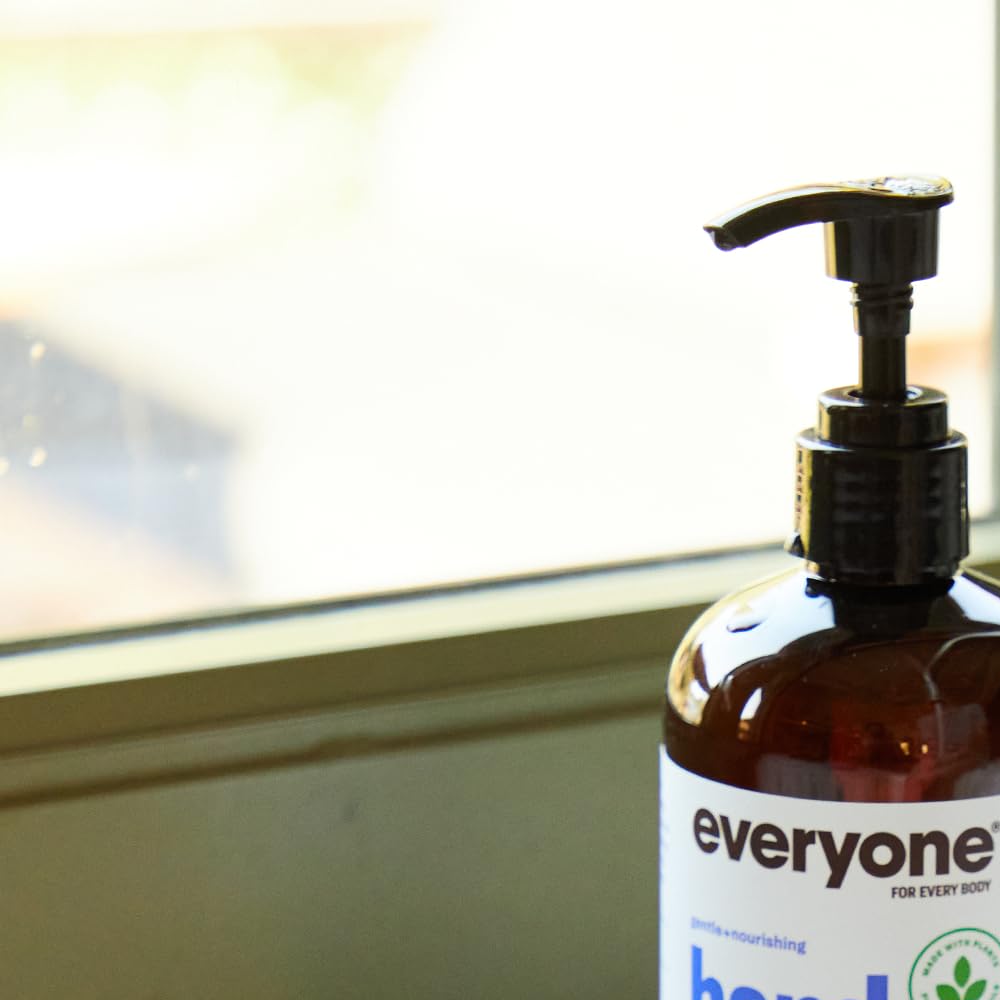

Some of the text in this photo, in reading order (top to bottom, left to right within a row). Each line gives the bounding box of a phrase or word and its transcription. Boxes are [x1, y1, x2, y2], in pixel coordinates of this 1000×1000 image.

[891, 880, 993, 899] FOR EVERY BODY
